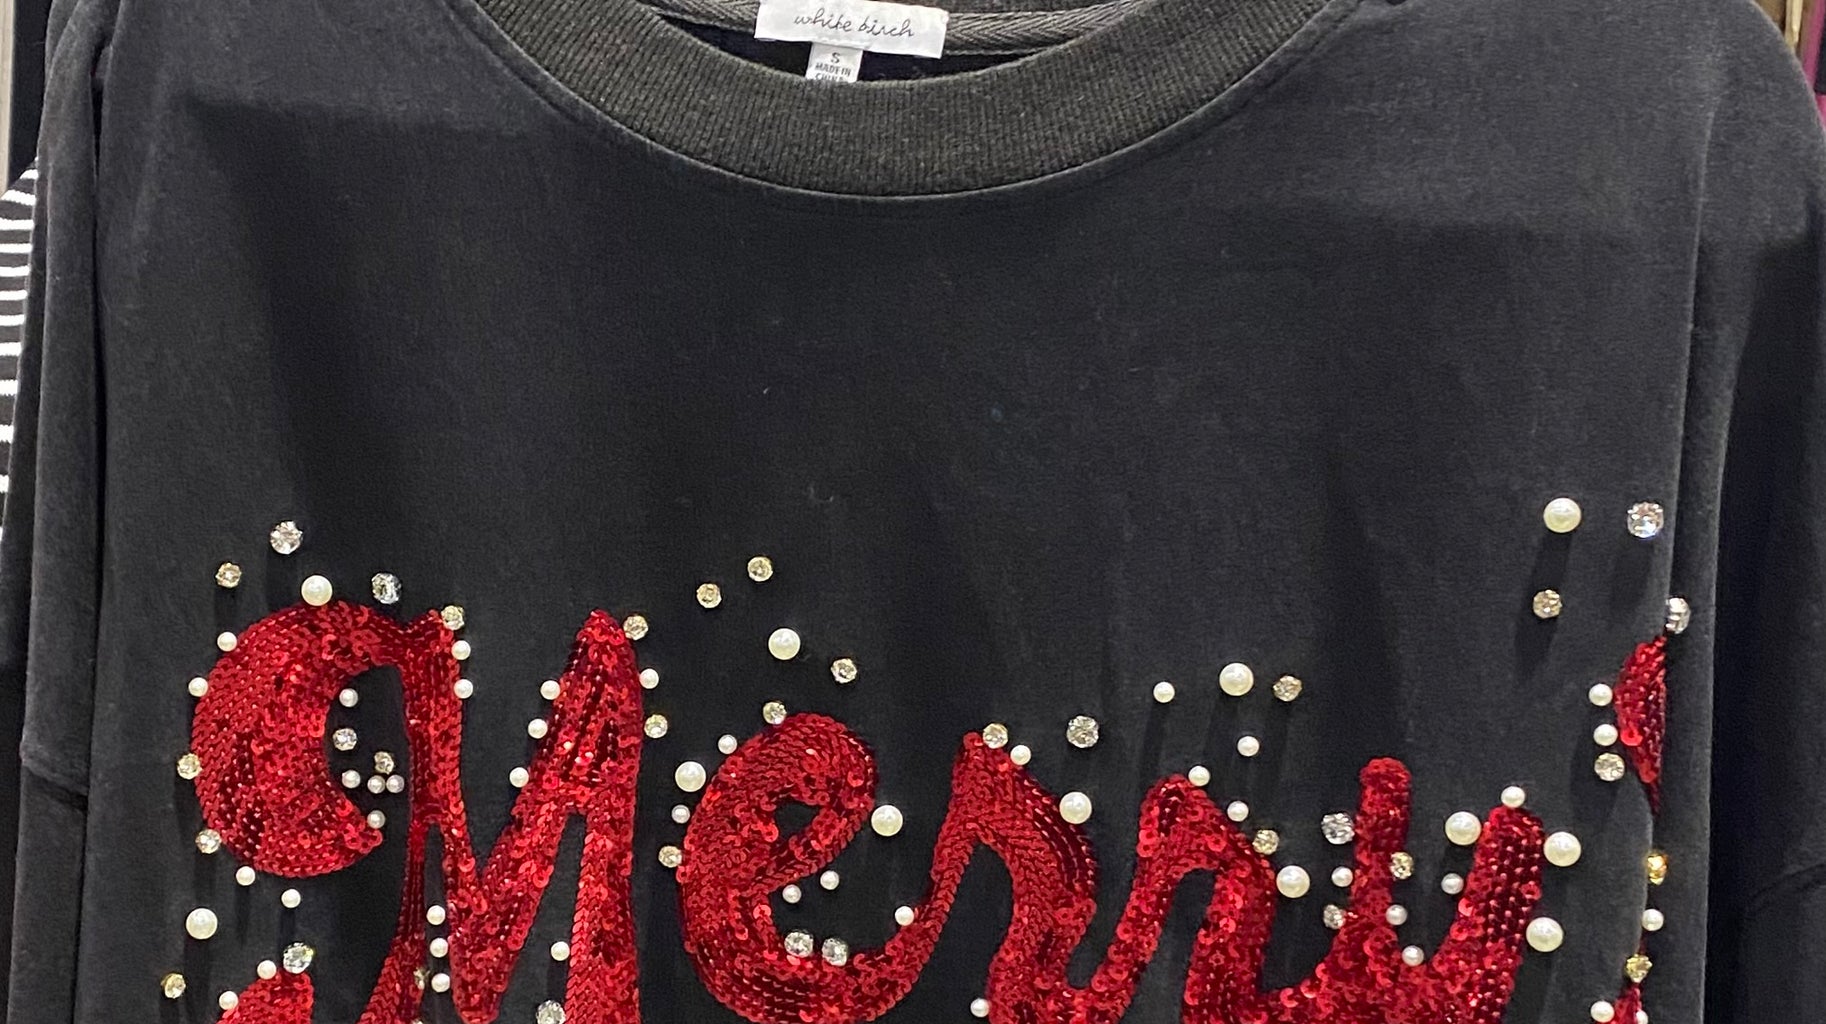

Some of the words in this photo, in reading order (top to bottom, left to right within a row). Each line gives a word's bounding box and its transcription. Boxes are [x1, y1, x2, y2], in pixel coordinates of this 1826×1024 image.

[794, 7, 852, 32] white
[858, 15, 915, 37] birch
[831, 52, 841, 63] S
[815, 62, 841, 75] MADE
[841, 67, 852, 77] IN
